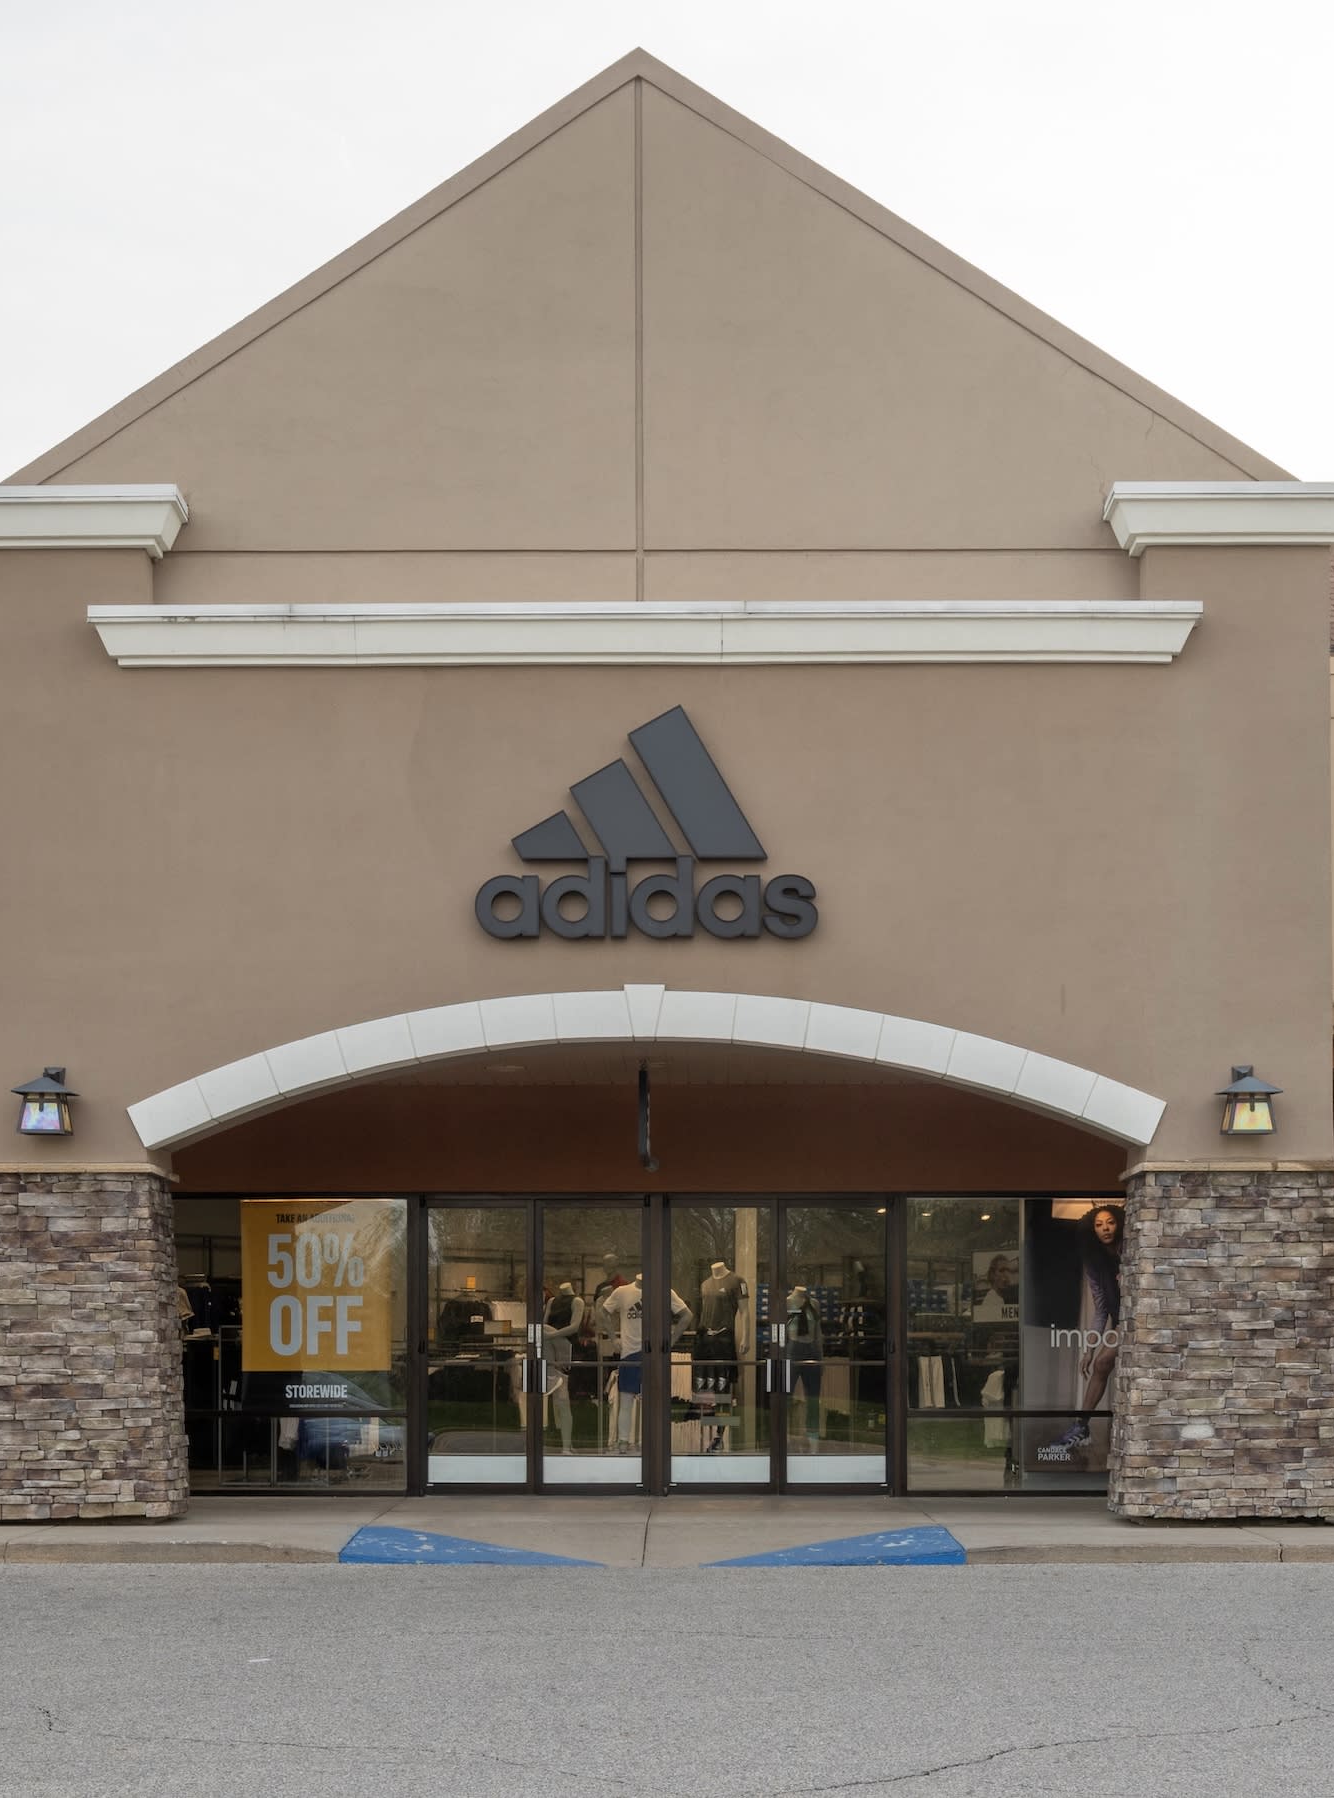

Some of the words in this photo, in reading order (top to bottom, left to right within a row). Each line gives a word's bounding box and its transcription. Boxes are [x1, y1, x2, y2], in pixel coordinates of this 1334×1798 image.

[475, 854, 819, 940] adidas
[275, 1213, 295, 1224] TAKE
[267, 1233, 364, 1288] 50%
[269, 1295, 364, 1356] OFF
[1051, 1323, 1119, 1353] impo
[285, 1384, 348, 1398] STOREWIDE
[1037, 1453, 1071, 1461] PARKER
